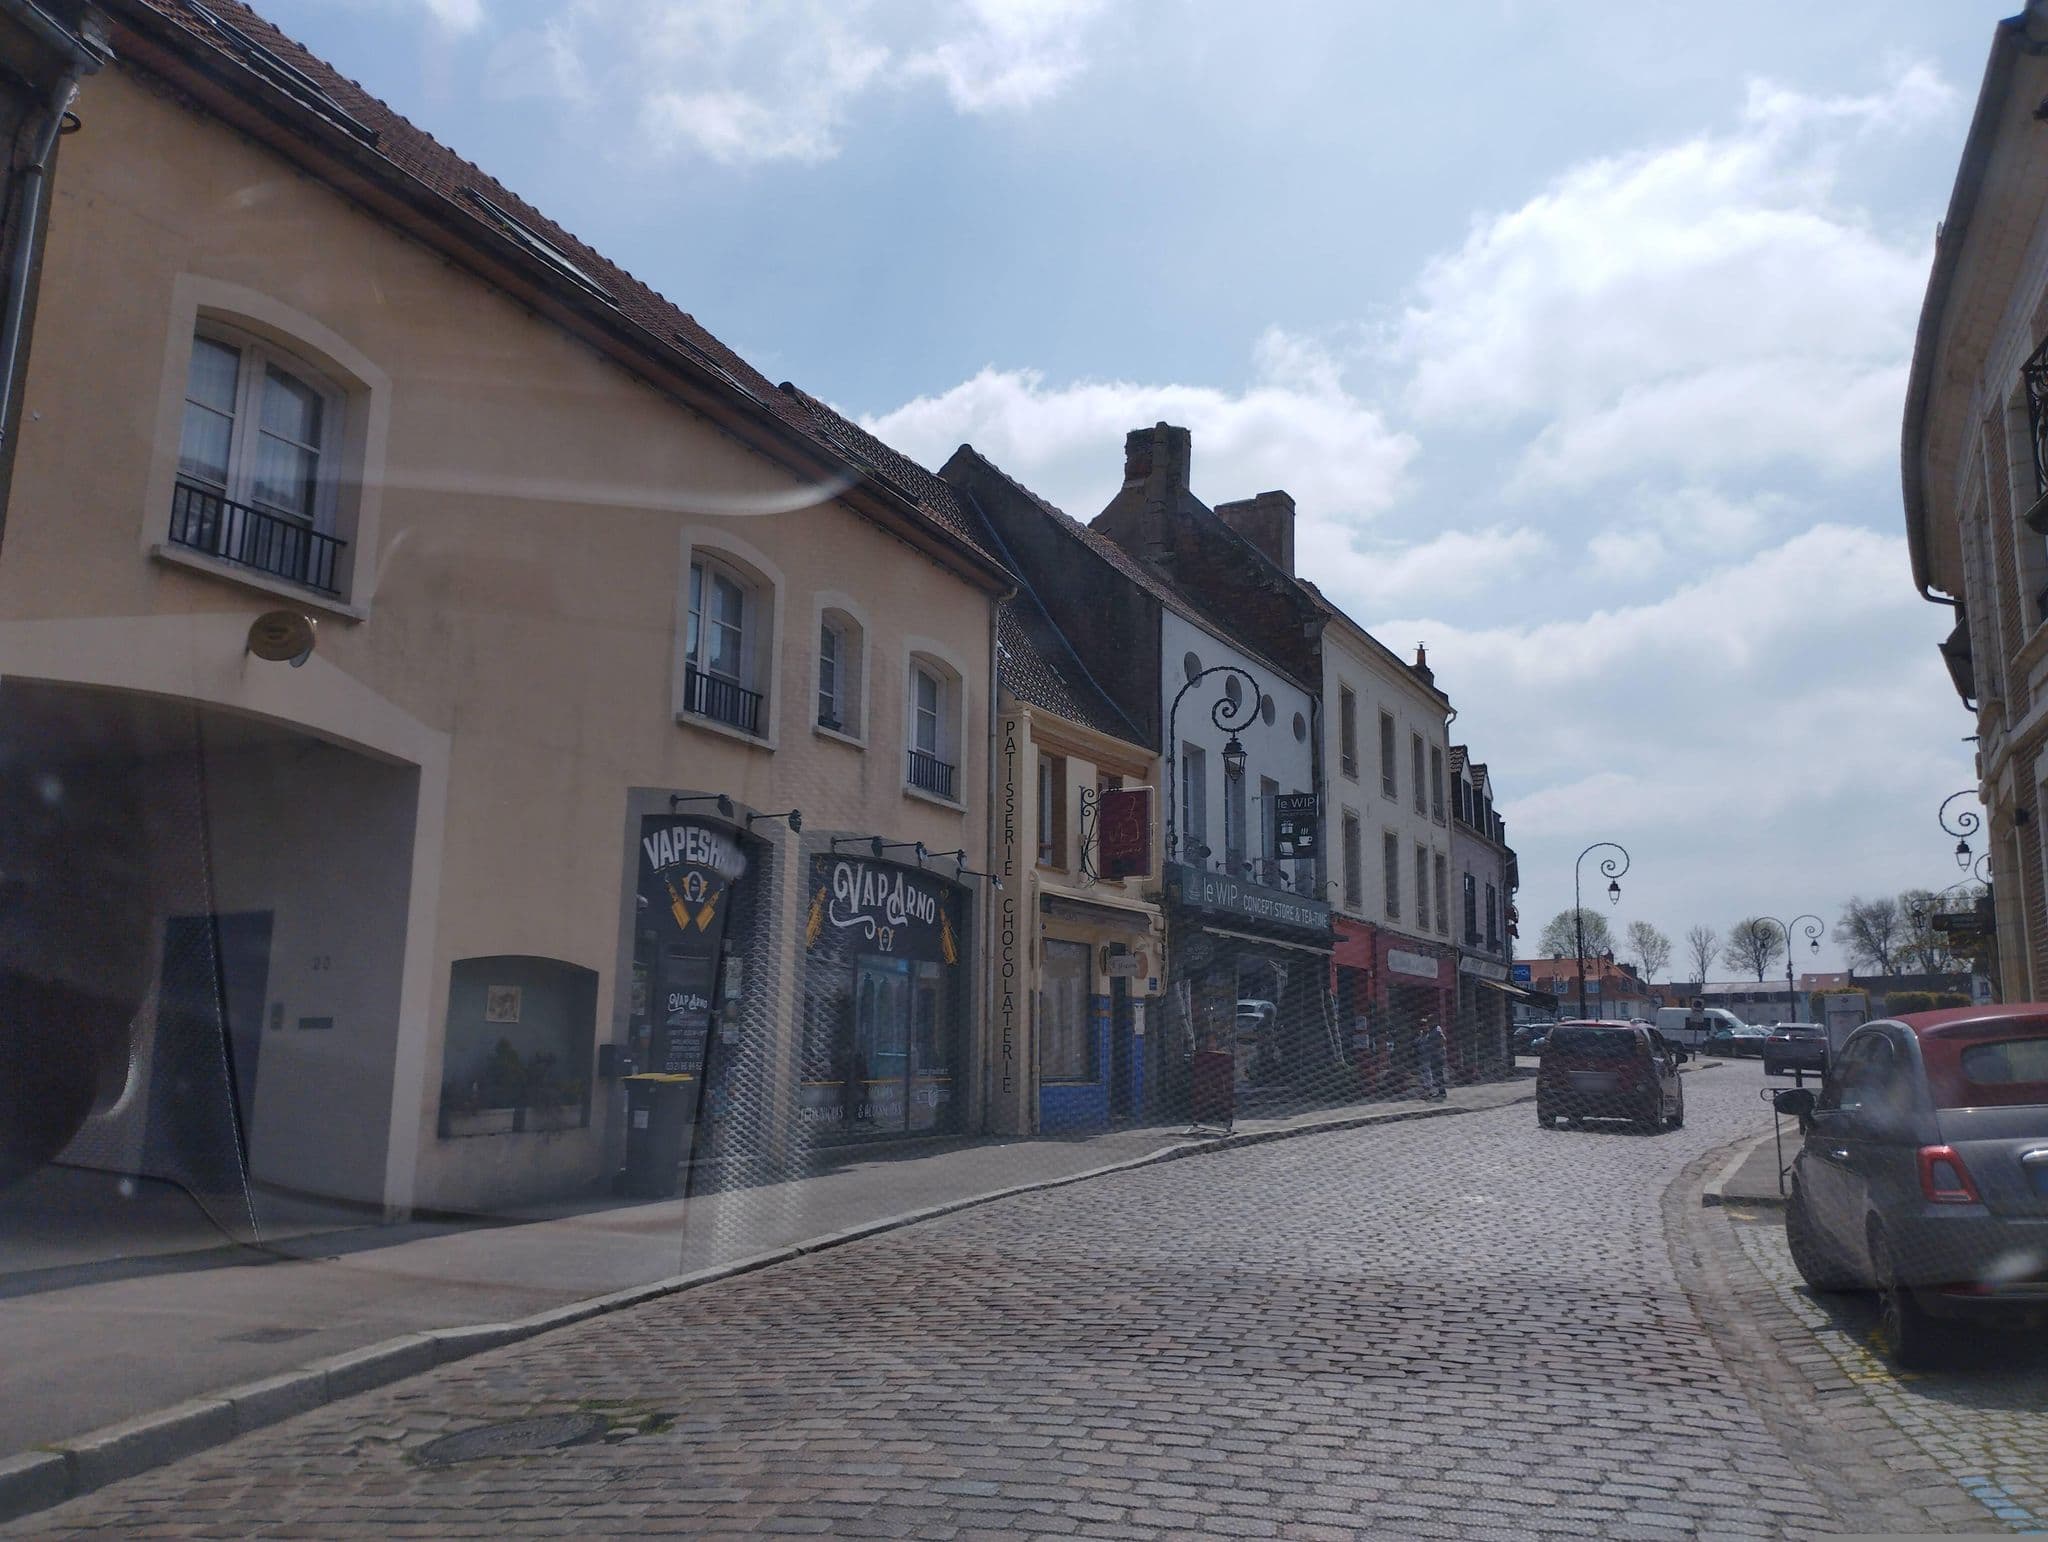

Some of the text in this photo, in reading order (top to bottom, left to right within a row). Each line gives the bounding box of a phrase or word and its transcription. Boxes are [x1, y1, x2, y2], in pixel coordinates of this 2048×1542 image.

[1277, 796, 1315, 809] le WIP
[643, 826, 746, 877] VAPESH
[1001, 721, 1017, 1094] PATISSERIE CHOCOLATERIE
[1203, 877, 1214, 902] le
[1216, 880, 1238, 907] WIP
